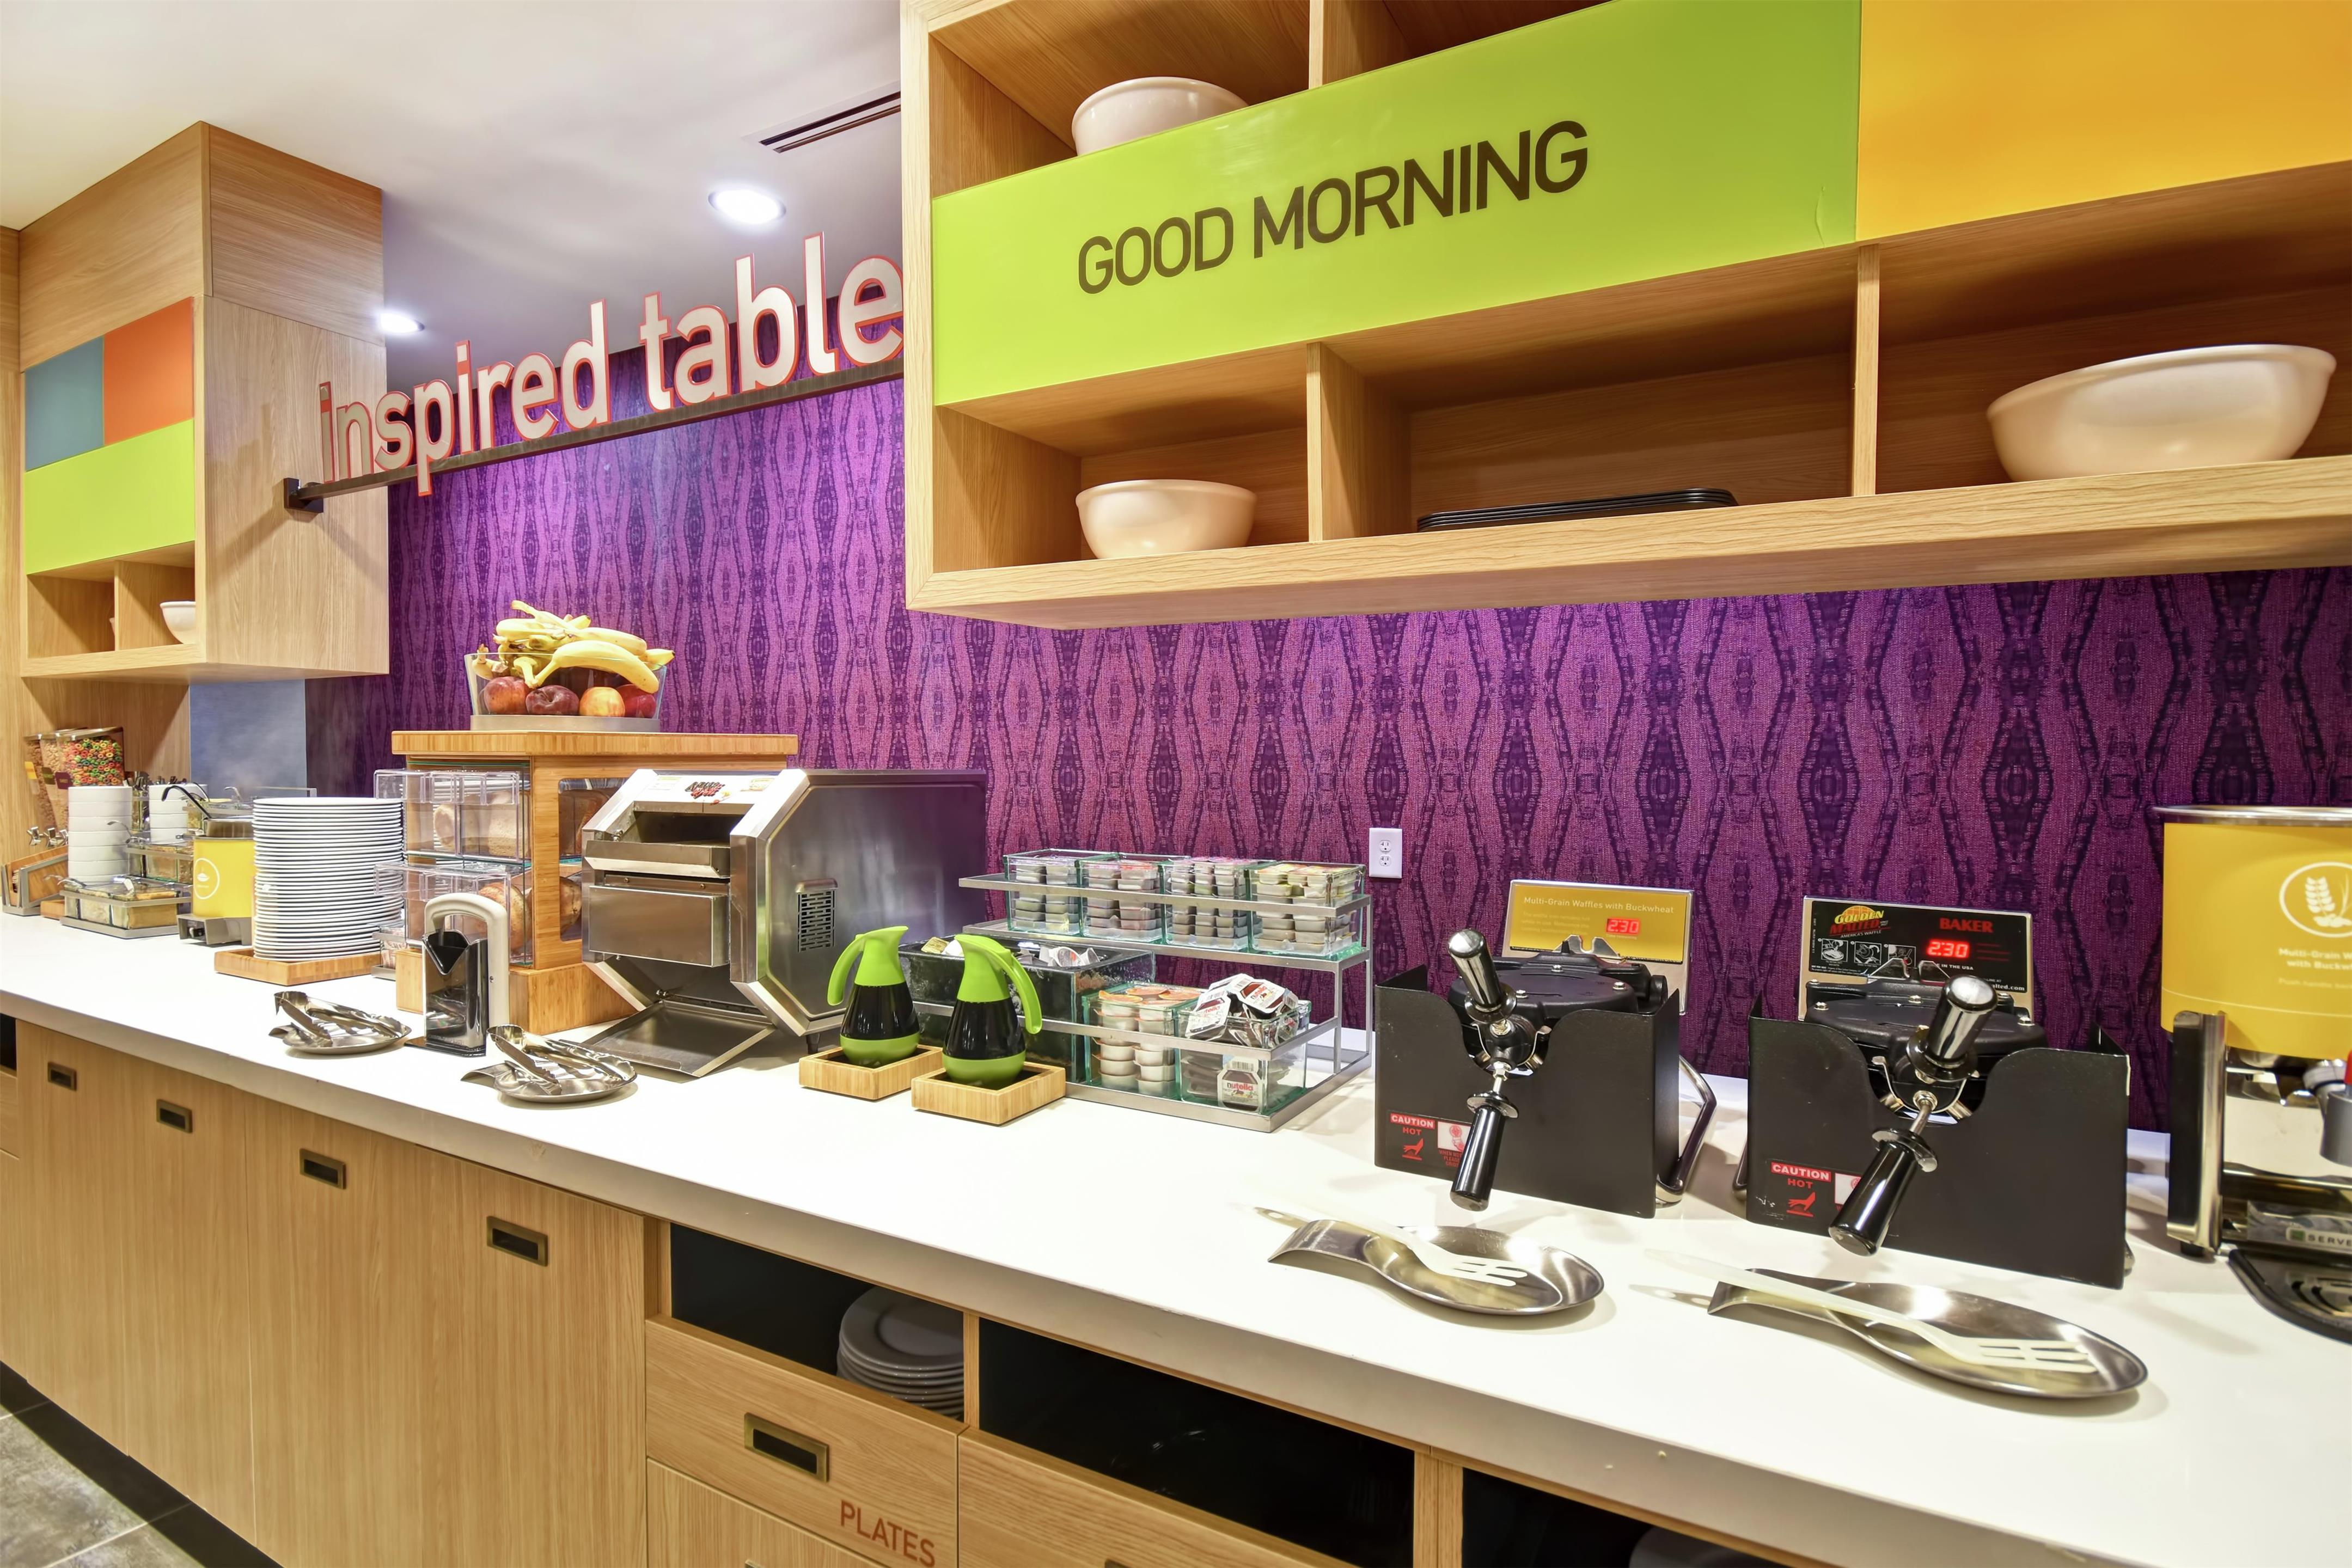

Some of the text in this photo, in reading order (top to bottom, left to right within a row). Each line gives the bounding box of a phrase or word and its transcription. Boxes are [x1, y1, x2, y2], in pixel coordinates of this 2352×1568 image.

[1078, 120, 1588, 295] GOOD MORNING
[320, 231, 904, 497] inspired table
[1524, 897, 1674, 914] Multi-Grain Waffles with Buckwheat
[1834, 910, 1884, 924] GOLDEN
[1830, 919, 1880, 934] MALTED
[1939, 917, 1994, 933] BAKER
[2278, 947, 2341, 959] Multi-Grain
[1227, 1082, 1254, 1091] nutella
[1391, 1114, 1434, 1129] CAUTION
[1402, 1127, 1422, 1136] HOT
[1773, 1164, 1830, 1181] CAUTION
[1787, 1178, 1814, 1189] HOT
[840, 1499, 936, 1568] PLATES
